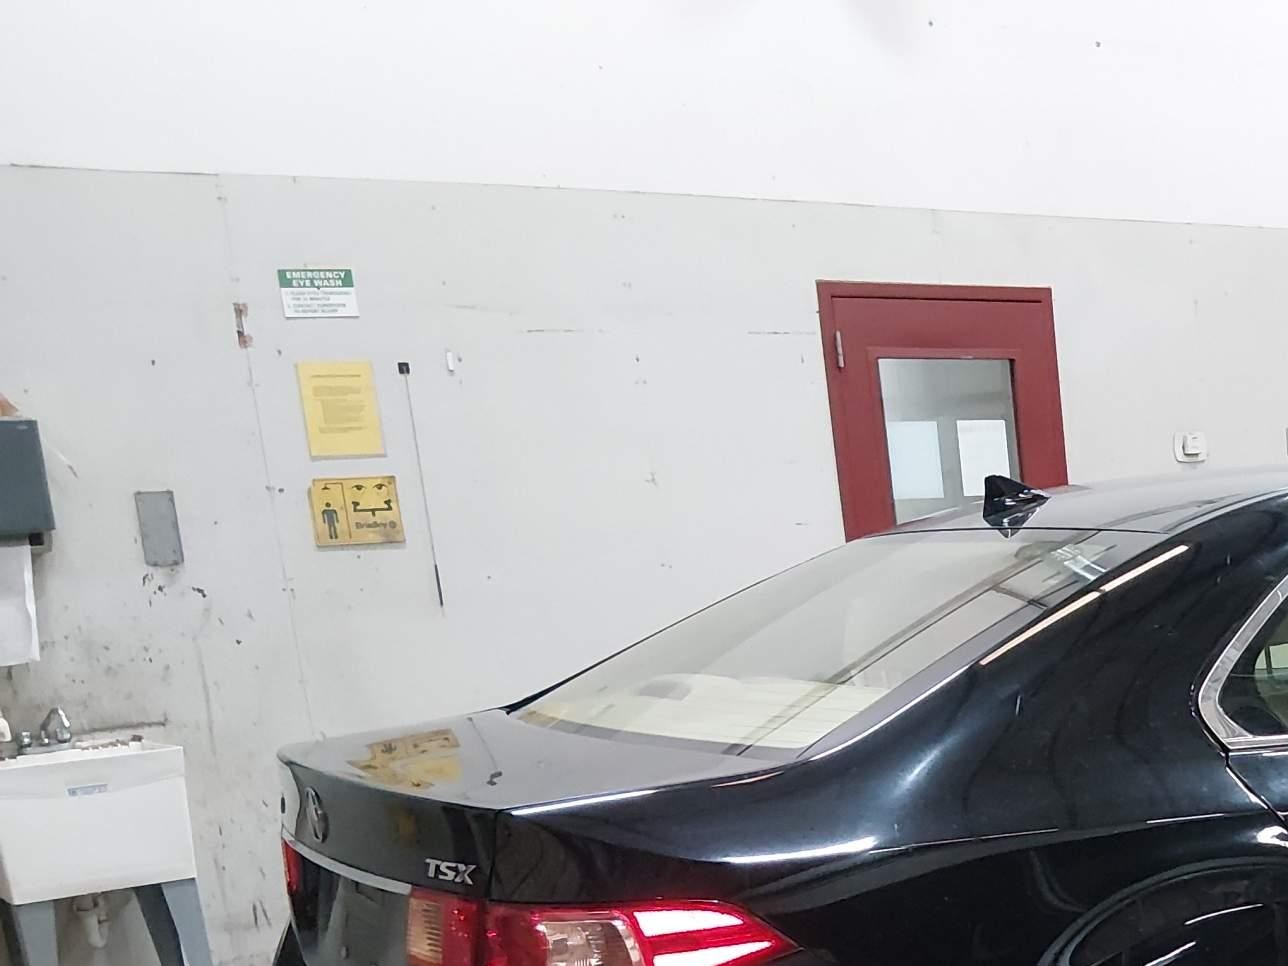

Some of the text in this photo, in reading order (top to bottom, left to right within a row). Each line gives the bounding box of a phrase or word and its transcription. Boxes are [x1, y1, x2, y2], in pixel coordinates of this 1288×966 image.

[285, 271, 346, 279] EMERGENCY
[292, 279, 343, 287] EYE WASH
[425, 858, 477, 886] TSX
